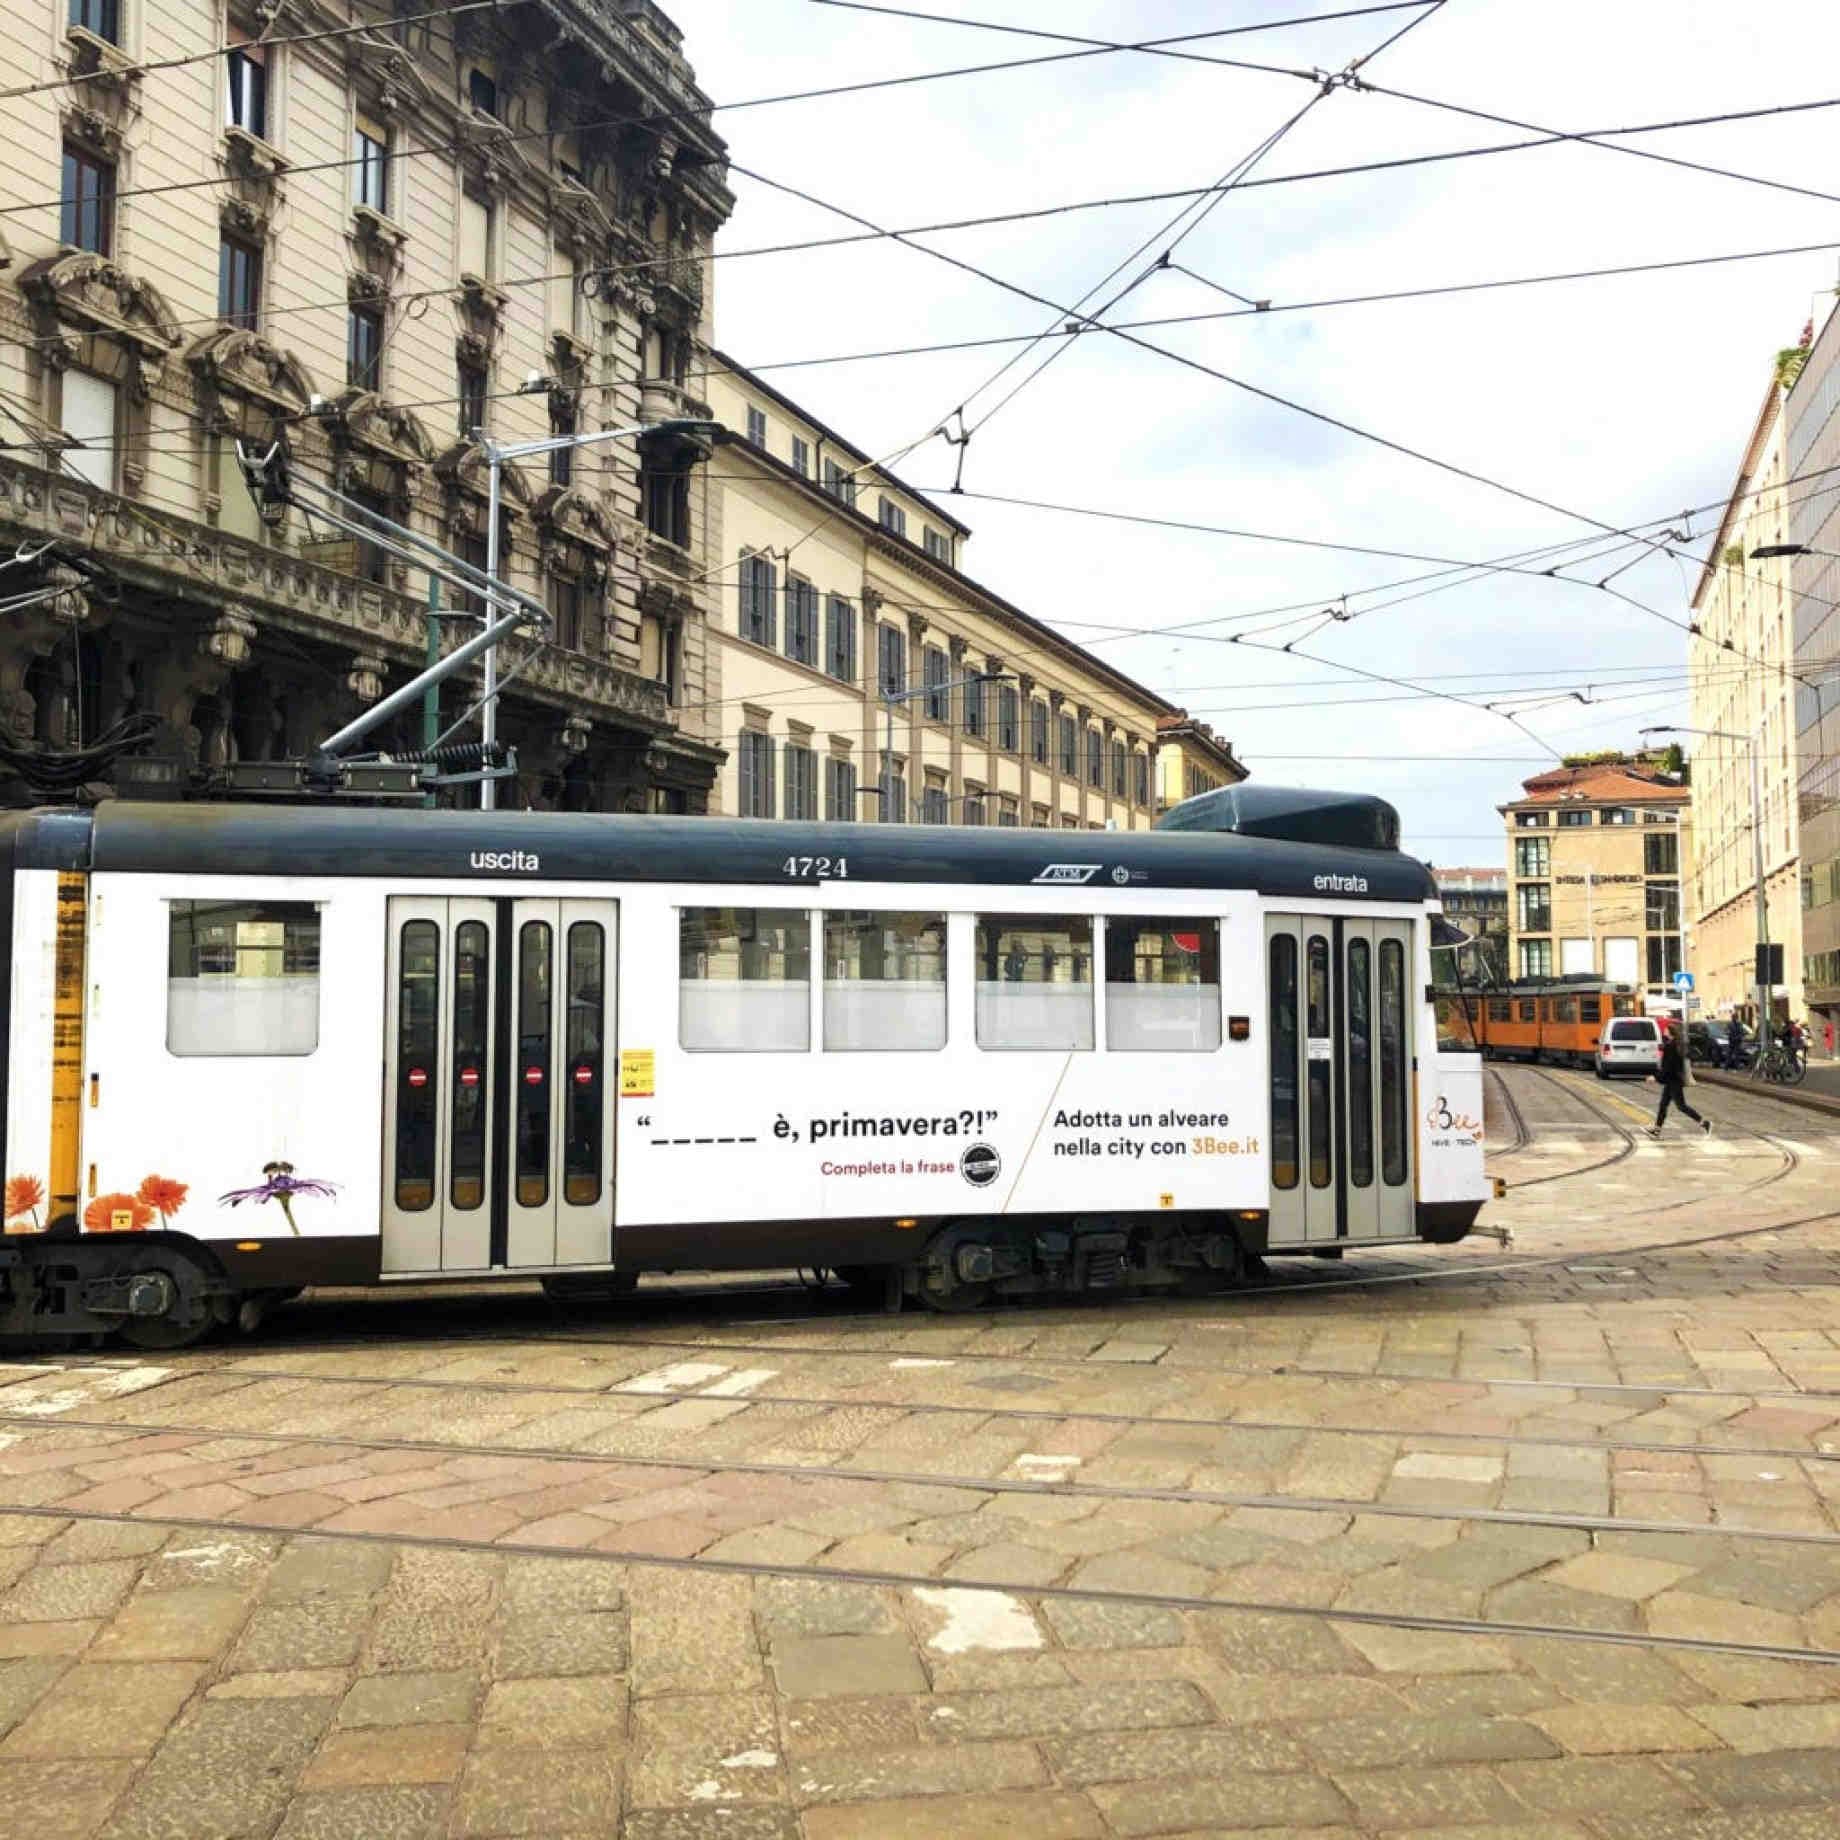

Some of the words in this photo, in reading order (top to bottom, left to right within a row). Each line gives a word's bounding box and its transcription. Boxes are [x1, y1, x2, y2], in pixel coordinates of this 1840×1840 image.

[470, 850, 540, 872] uscita
[782, 857, 848, 878] 4724
[1313, 873, 1369, 893] entrata
[773, 1113, 799, 1143] è,
[1054, 1109, 1122, 1128] Adotta
[1128, 1114, 1152, 1127] un
[1158, 1109, 1229, 1127] alveare
[1054, 1137, 1101, 1155] nella
[1107, 1137, 1145, 1159] city
[1151, 1142, 1186, 1155] con
[1192, 1136, 1260, 1154] 3Bee.it
[820, 1160, 896, 1177] Completa
[900, 1159, 914, 1174] la
[918, 1158, 955, 1174] frase
